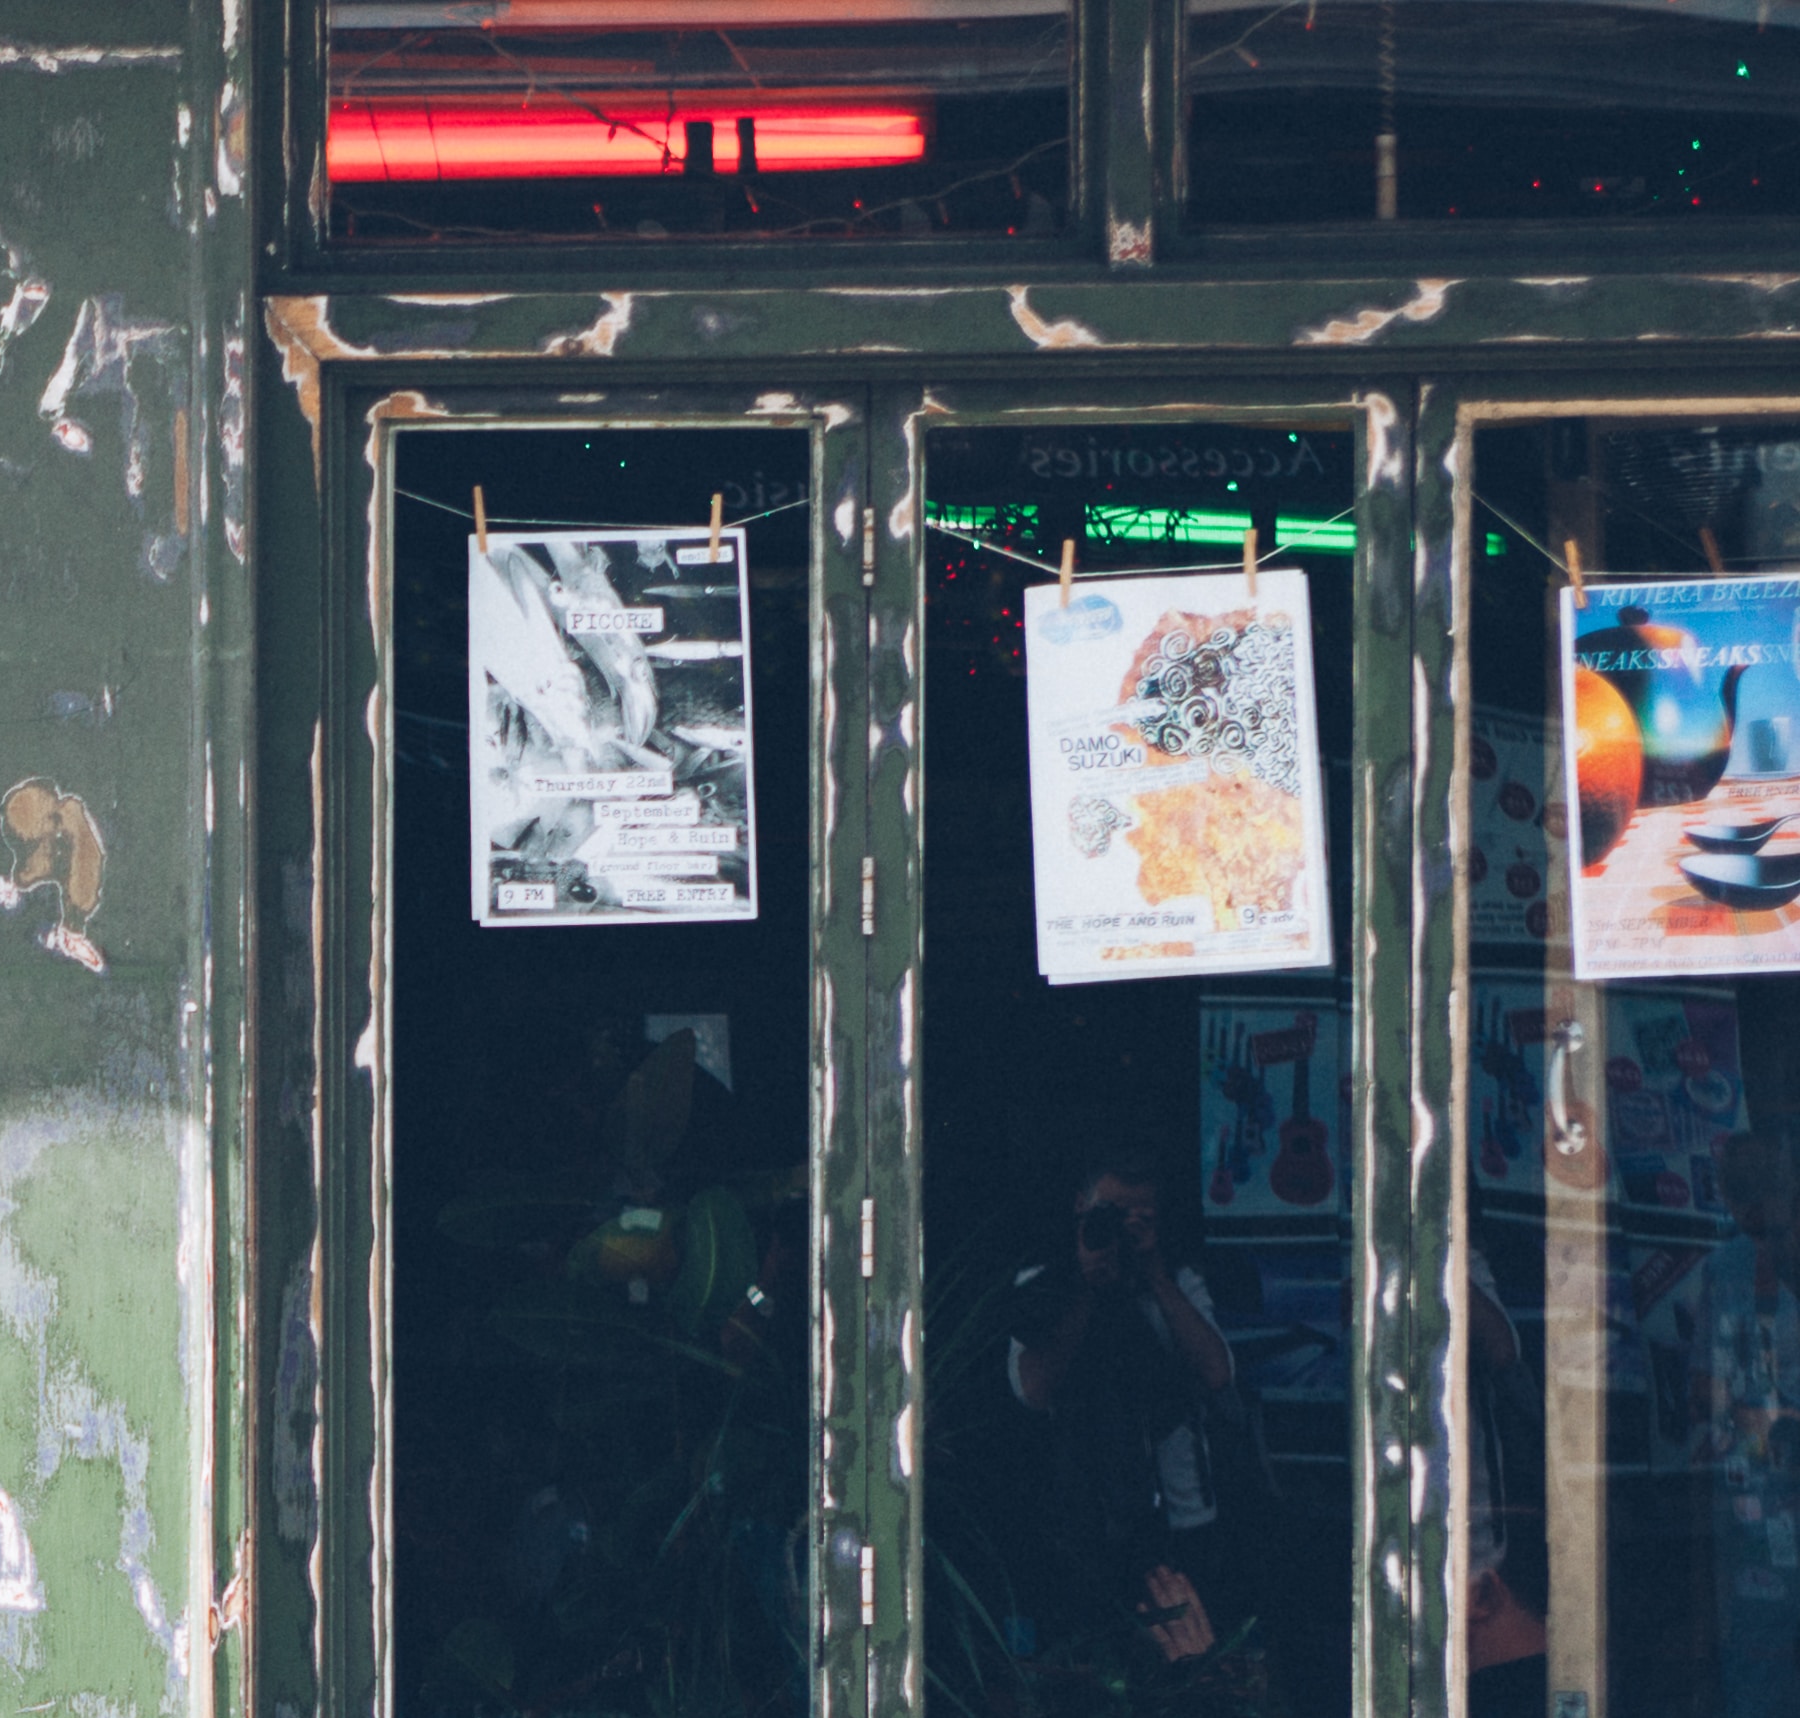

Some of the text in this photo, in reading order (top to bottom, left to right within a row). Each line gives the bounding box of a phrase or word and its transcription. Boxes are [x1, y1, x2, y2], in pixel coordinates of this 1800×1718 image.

[1600, 586, 1703, 607] RIVIERA
[571, 612, 653, 630] PICORE
[1060, 734, 1120, 754] DAMO
[1068, 747, 1141, 771] SUZUKI
[535, 778, 617, 792] Thursday
[601, 805, 694, 820] September
[618, 831, 731, 847] Hope & Ruin
[647, 860, 682, 872] floor
[503, 889, 546, 904] 9 PM
[626, 889, 729, 902] FREE ENTRY
[1046, 914, 1197, 931] THE HOPE AND RUIN
